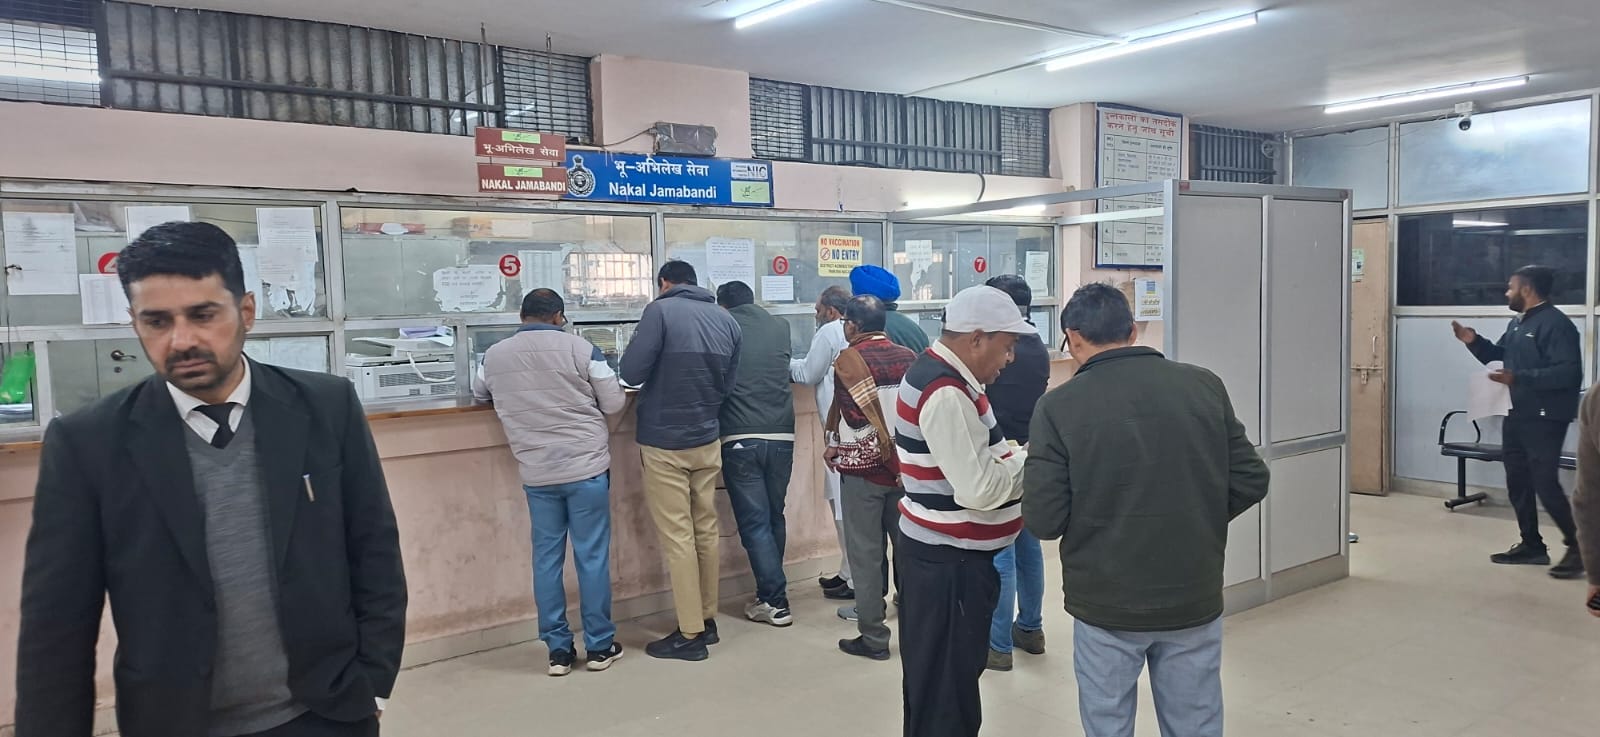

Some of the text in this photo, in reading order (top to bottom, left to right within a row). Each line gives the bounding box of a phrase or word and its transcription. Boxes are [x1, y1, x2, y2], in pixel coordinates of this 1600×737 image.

[540, 146, 559, 157] सेवा
[686, 160, 710, 177] सेवा
[481, 178, 566, 191] NAKAL JAMABANDI
[609, 182, 717, 199] Nakal Jamabandi
[820, 238, 860, 248] NO VACCINATION
[832, 248, 859, 261] NO ENTRY
[503, 256, 517, 275] 5
[774, 256, 787, 274] 6
